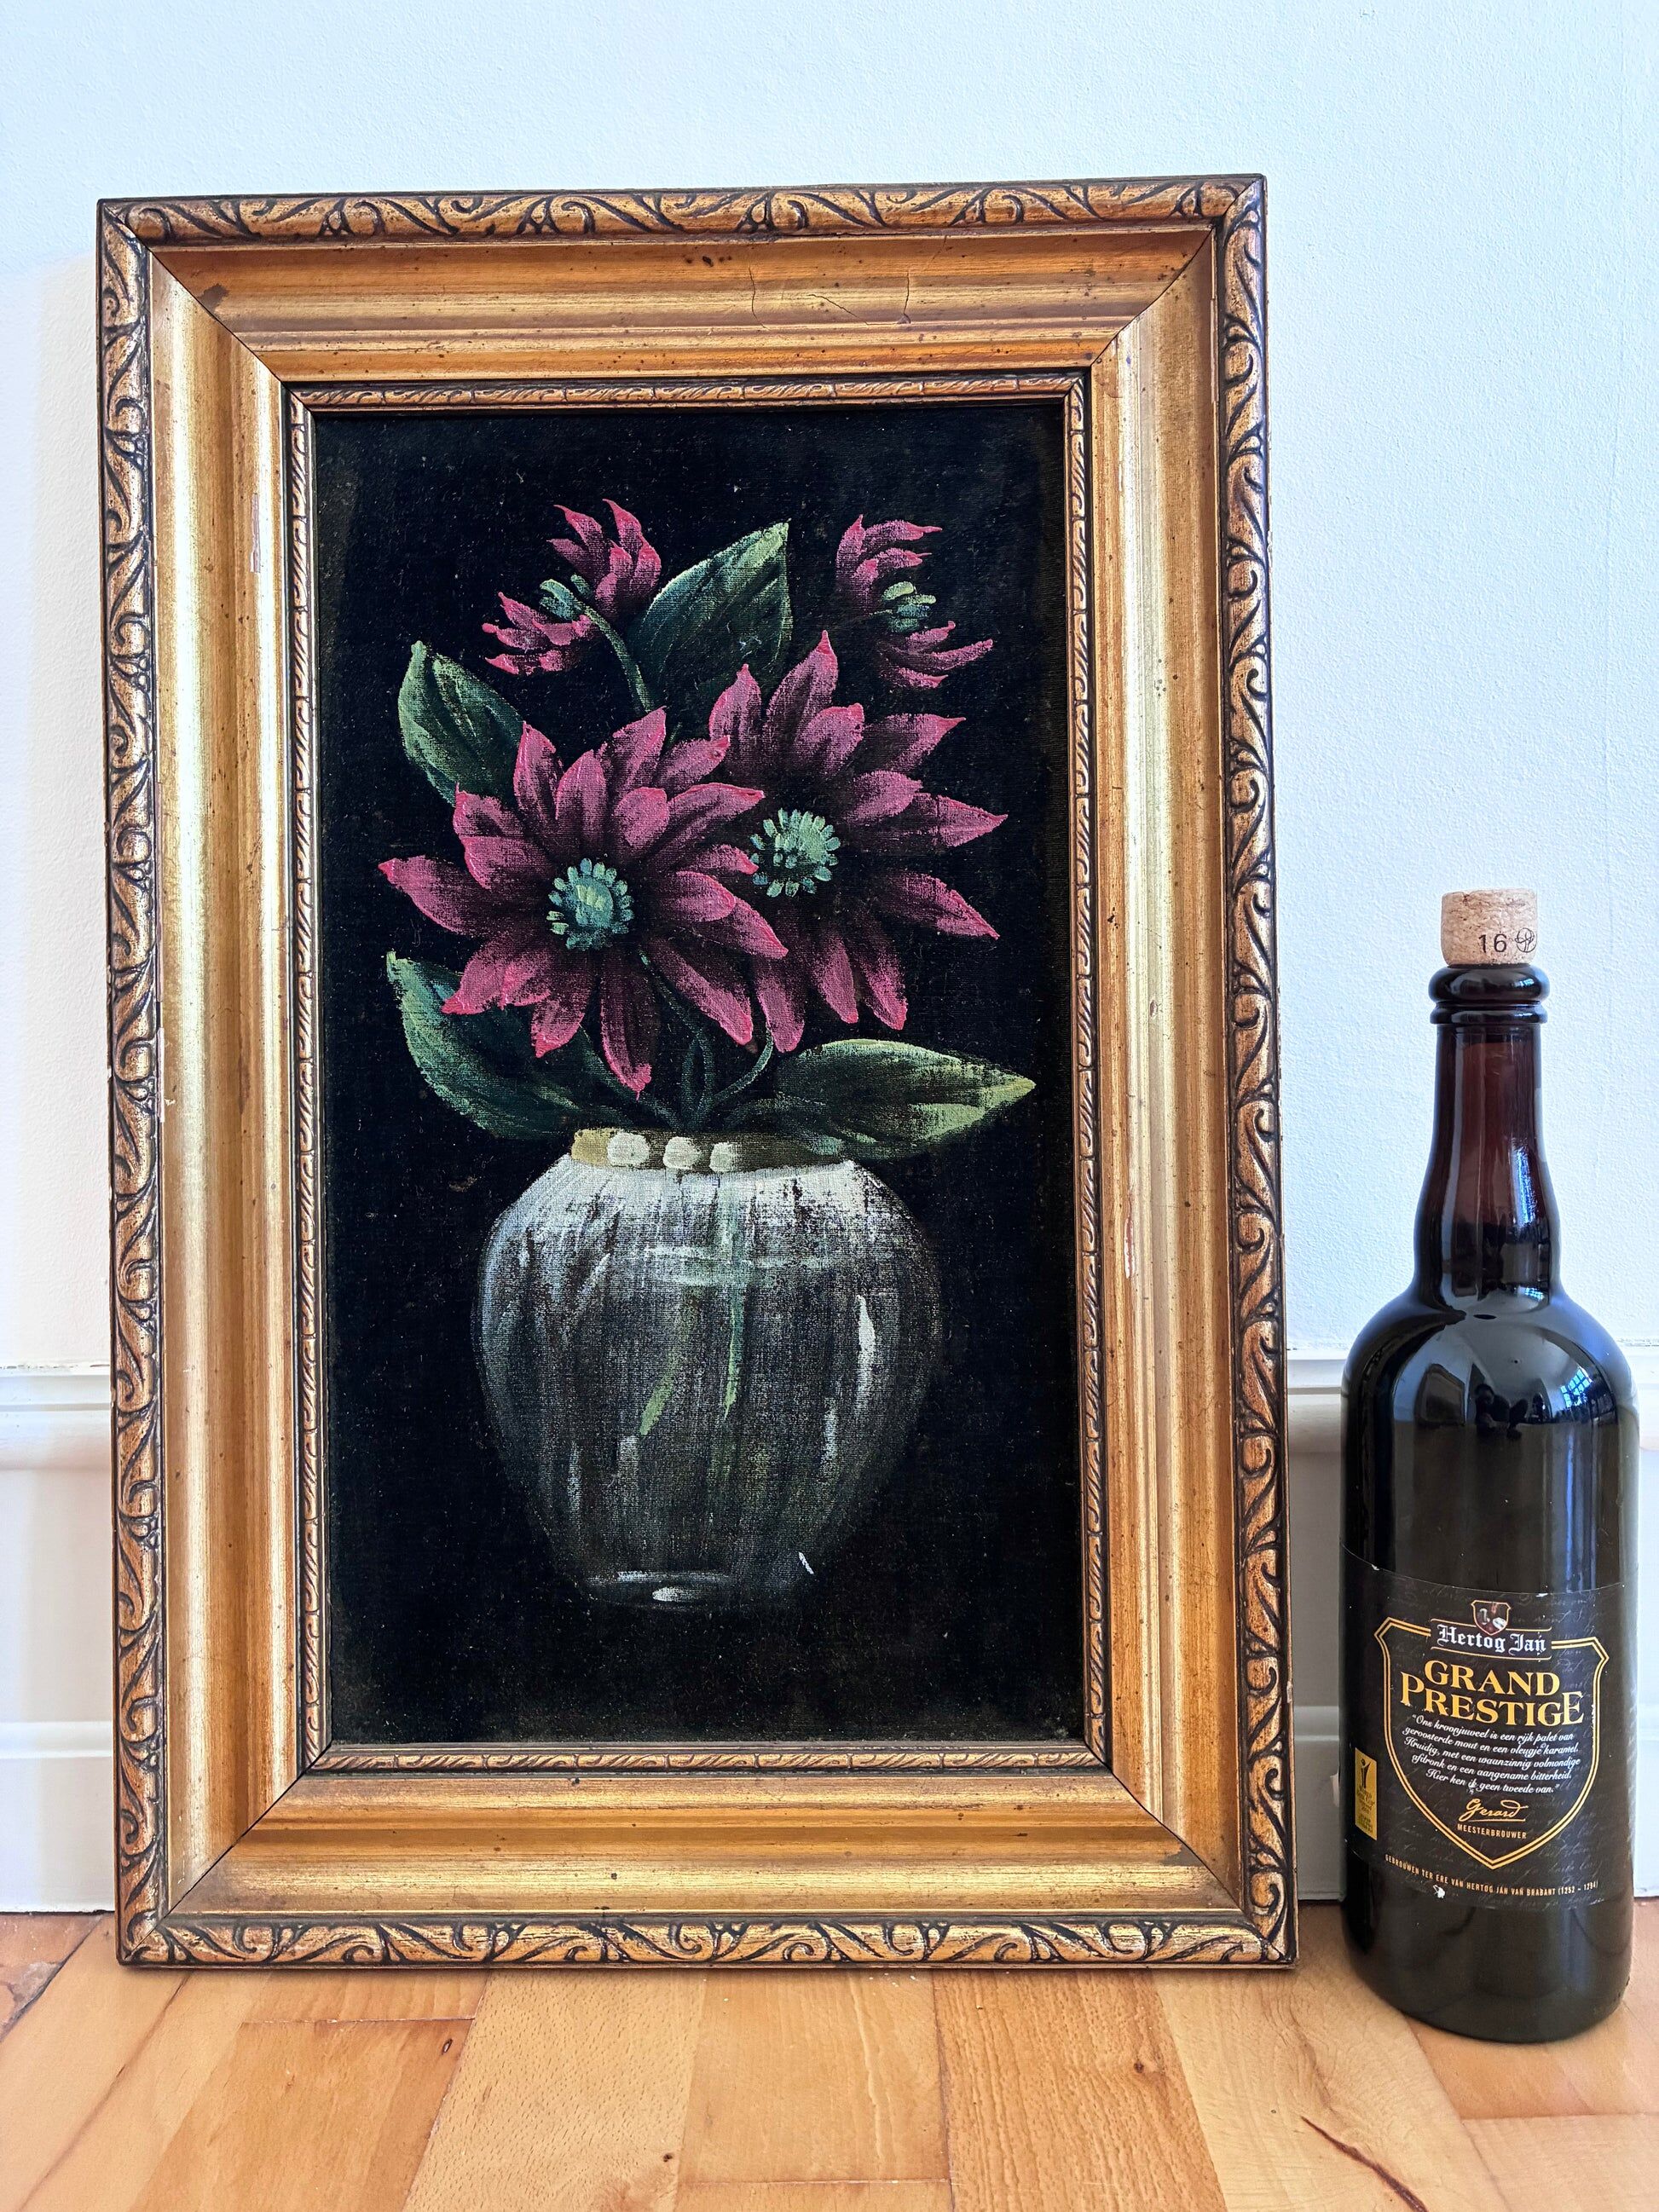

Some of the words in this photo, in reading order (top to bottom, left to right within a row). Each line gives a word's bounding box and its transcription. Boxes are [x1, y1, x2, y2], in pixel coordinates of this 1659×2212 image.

[1478, 933, 1507, 953] 16
[1436, 1623, 1506, 1654] Hertog
[1507, 1632, 1546, 1656] Jan
[1424, 1660, 1560, 1696] GRAND
[1400, 1671, 1585, 1727] PRESTIGE
[1402, 1727, 1454, 1745] geroosterde
[1454, 1740, 1479, 1750] mout
[1511, 1742, 1542, 1758] vleugje
[1543, 1741, 1579, 1754] karamel.
[1434, 1719, 1489, 1739] kroonjuweel
[1489, 1730, 1499, 1739] is
[1517, 1731, 1535, 1745] rijk
[1533, 1731, 1557, 1745] palet
[1558, 1733, 1573, 1742] van
[1404, 1736, 1440, 1757] Kruidig,
[1442, 1749, 1460, 1759] met
[1478, 1756, 1532, 1770] waanzinnig
[1534, 1756, 1581, 1769] volmondige
[1411, 1753, 1445, 1769] afdronk
[1447, 1764, 1458, 1772] en
[1477, 1769, 1529, 1781] aangename
[1530, 1769, 1571, 1781] bitterheid.
[1425, 1768, 1448, 1782] Hier
[1450, 1774, 1466, 1786] ken
[1467, 1778, 1477, 1788] ik
[1476, 1782, 1500, 1792] geen
[1503, 1783, 1534, 1793] tweede
[1458, 1798, 1529, 1822] Gerard
[1457, 1823, 1527, 1839] MEESTERBROUWER
[1384, 1854, 1419, 1875] GEBROUWEN
[1421, 1869, 1433, 1880] TER
[1436, 1874, 1448, 1885] ERE
[1451, 1878, 1464, 1888] VAN
[1466, 1882, 1493, 1893] HERTOG
[1496, 1885, 1508, 1895] JAN
[1511, 1887, 1523, 1896] VAN
[1526, 1887, 1556, 1897] BRABANT
[1558, 1885, 1575, 1895] (1252
